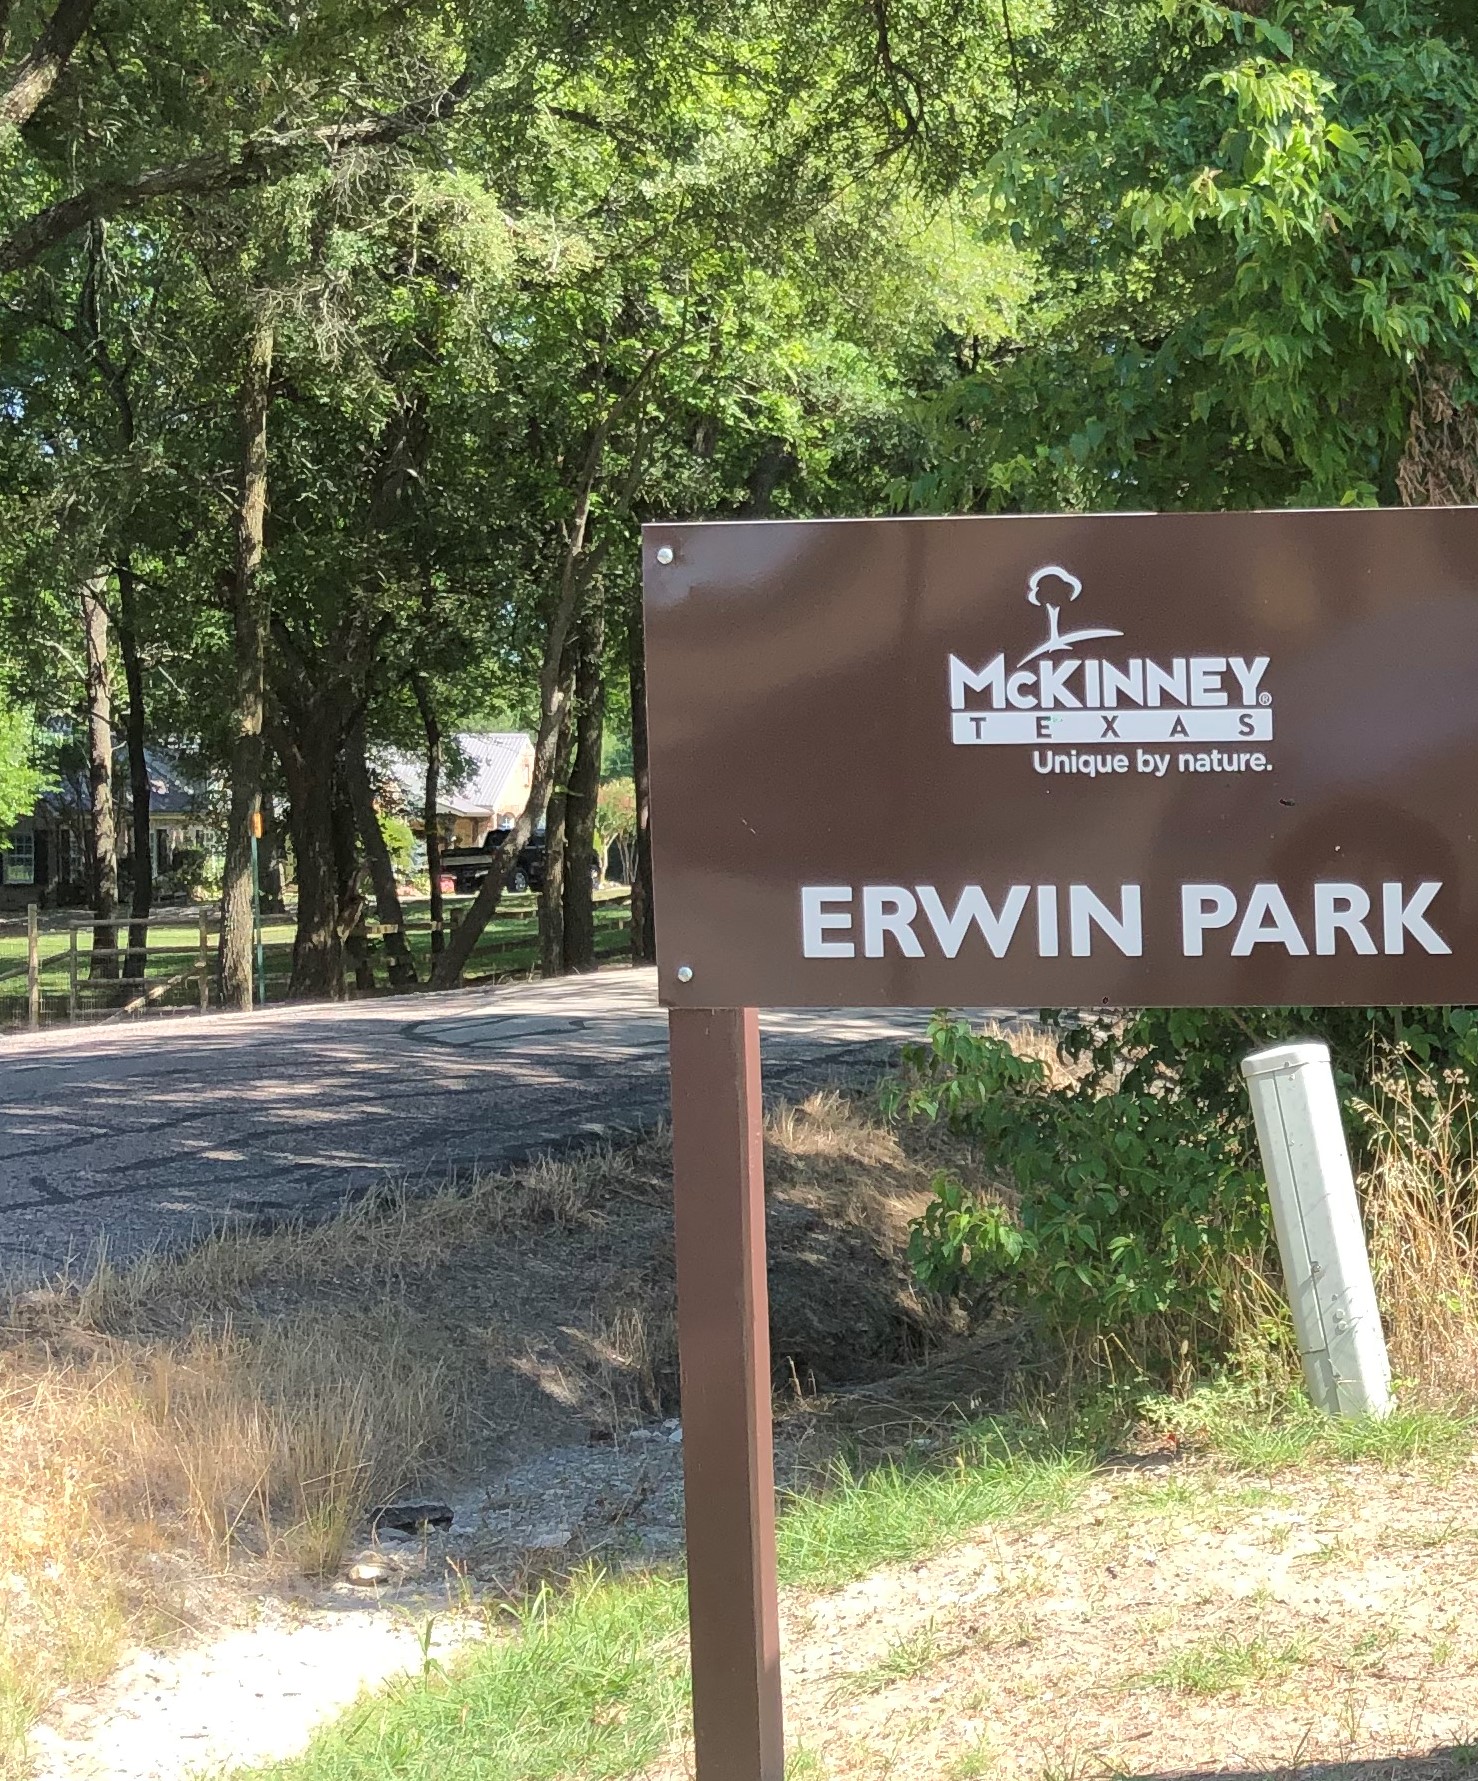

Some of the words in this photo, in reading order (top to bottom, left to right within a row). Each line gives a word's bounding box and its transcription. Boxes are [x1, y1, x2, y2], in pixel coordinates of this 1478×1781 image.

[970, 715, 1255, 740] TEXAS
[1034, 750, 1129, 778] Unique
[1137, 749, 1170, 777] by
[1178, 750, 1273, 772] nature.
[801, 884, 1143, 959] ERWIN
[1181, 882, 1453, 957] PARK
